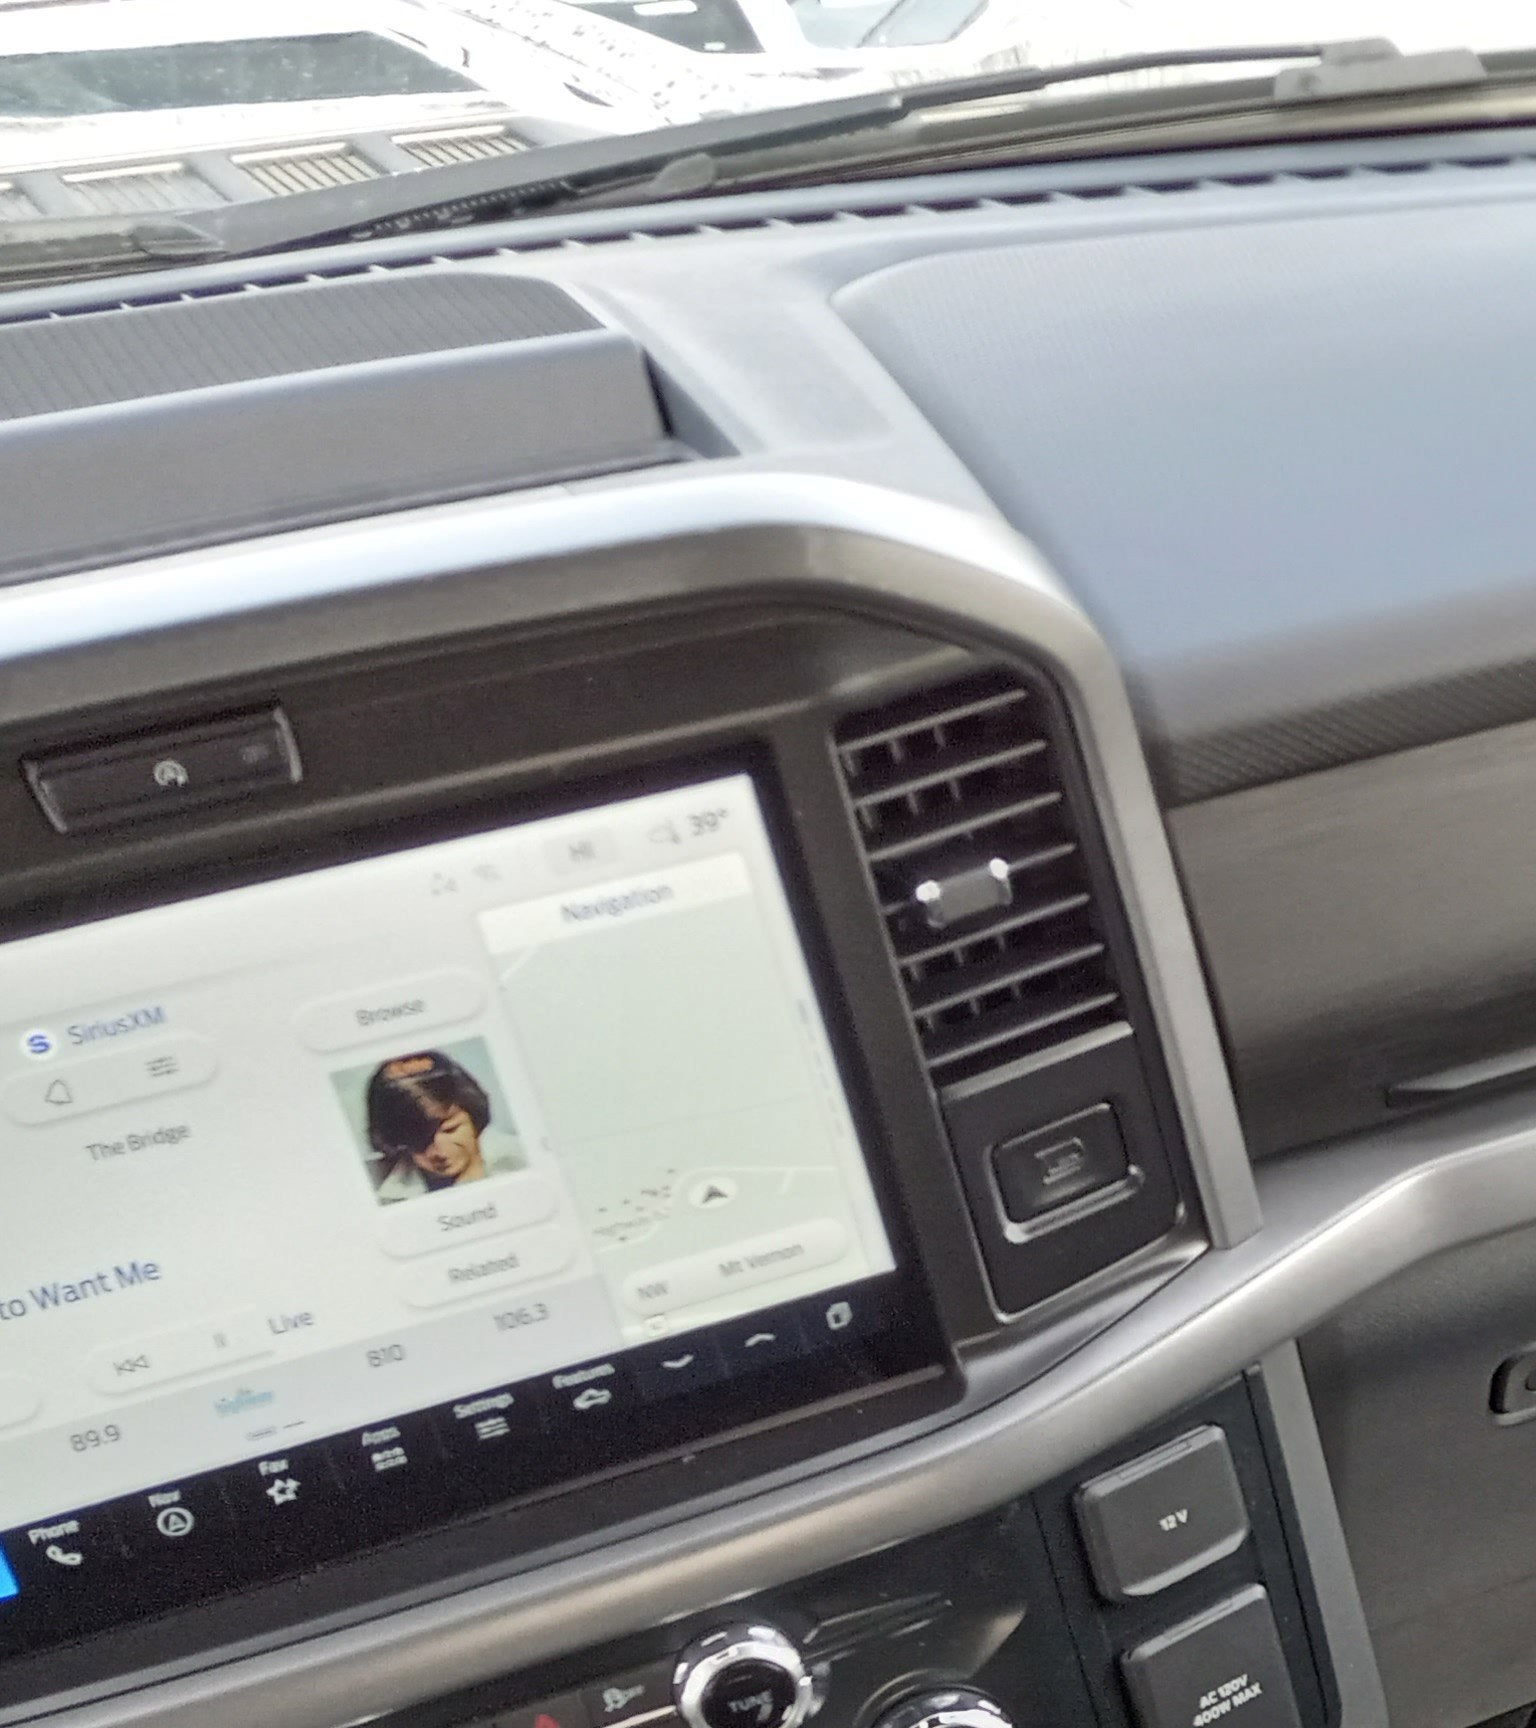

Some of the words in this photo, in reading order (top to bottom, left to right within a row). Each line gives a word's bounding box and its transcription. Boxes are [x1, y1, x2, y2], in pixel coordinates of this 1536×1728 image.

[561, 885, 674, 923] Navigation
[68, 1006, 165, 1045] SiriusXM
[356, 999, 425, 1026] Browse
[85, 1142, 125, 1161] The
[126, 1125, 190, 1151] Bridge
[437, 1202, 497, 1232] Sound
[0, 1298, 27, 1322] to
[28, 1272, 113, 1312] Want
[113, 1260, 162, 1290] Me
[267, 1310, 315, 1335] Live
[494, 1302, 548, 1331] 106.3
[366, 1343, 404, 1368] 810
[70, 1423, 122, 1452] 89.9
[28, 1520, 80, 1545] Phone
[1193, 1698, 1231, 1728] 400W
[1233, 1682, 1263, 1708] MAX
[1199, 1691, 1218, 1711] AC
[1216, 1673, 1249, 1700] 120V
